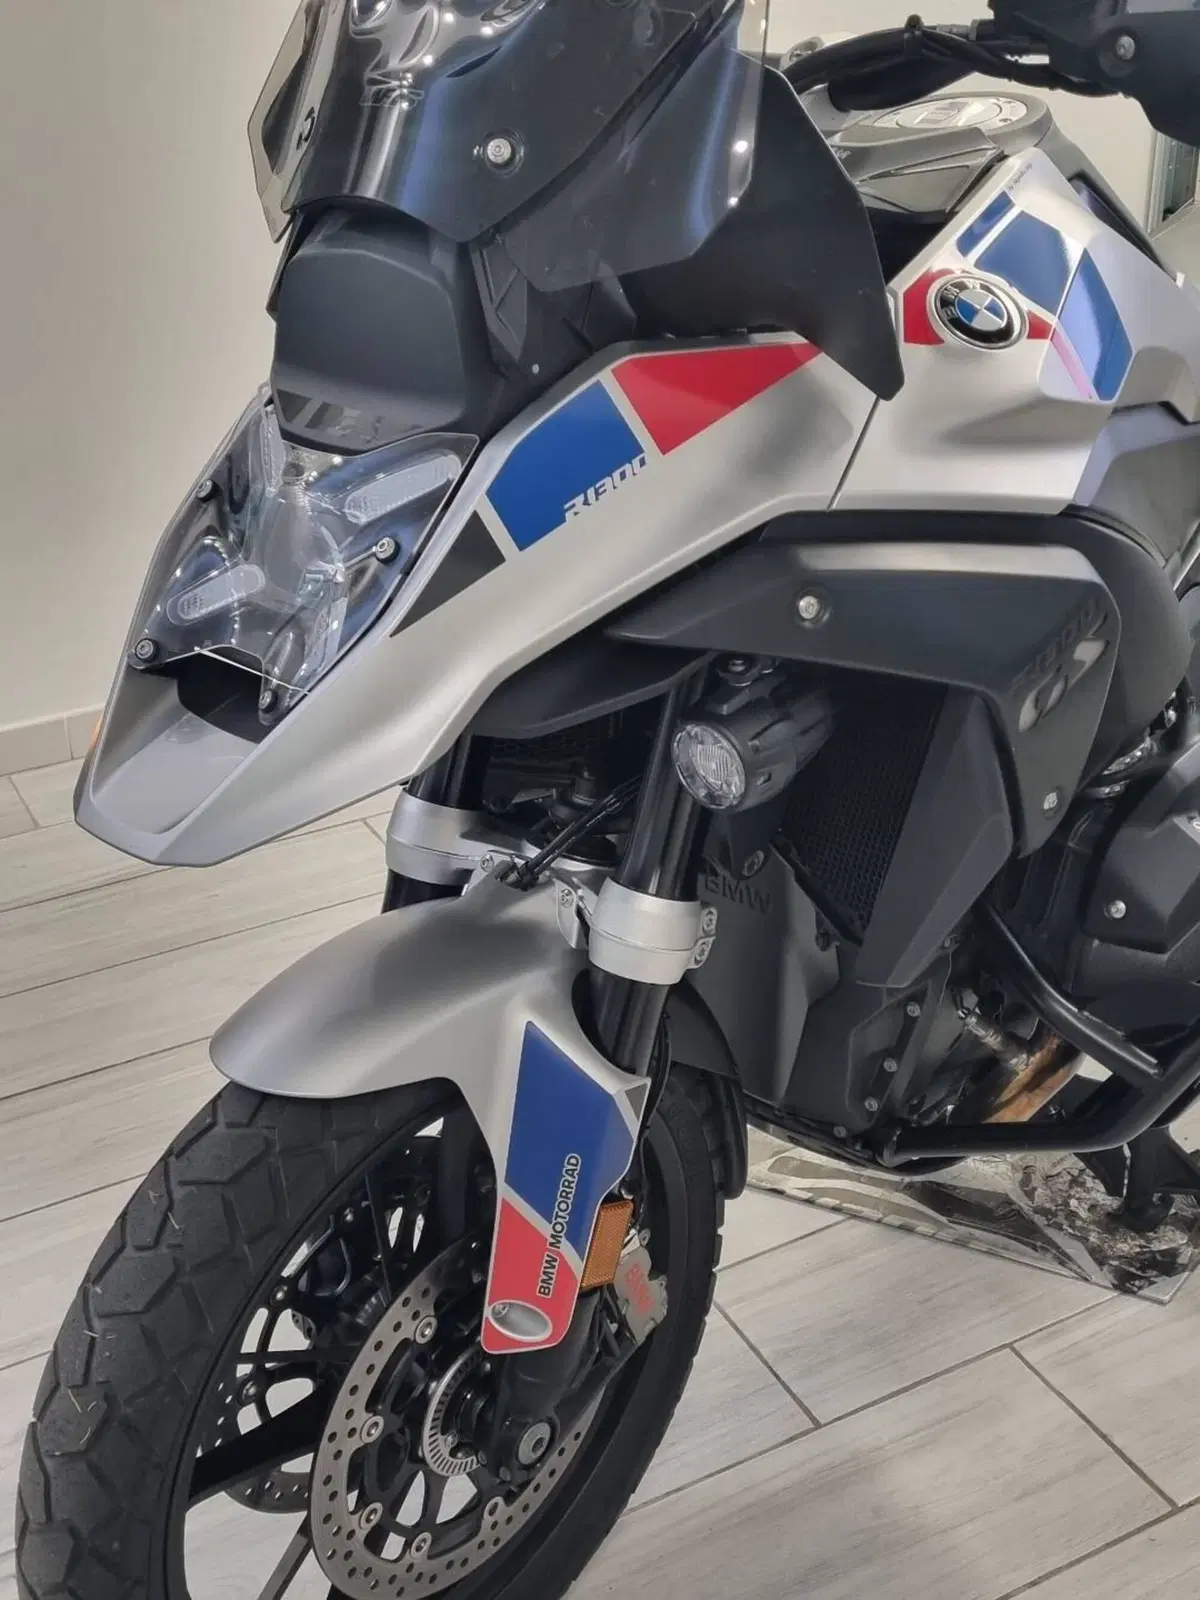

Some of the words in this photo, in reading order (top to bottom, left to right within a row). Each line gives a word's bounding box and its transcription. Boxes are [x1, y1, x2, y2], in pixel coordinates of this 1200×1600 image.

[704, 874, 773, 914] BMW
[538, 1253, 558, 1297] BMW
[549, 1154, 580, 1249] MOTORRAD
